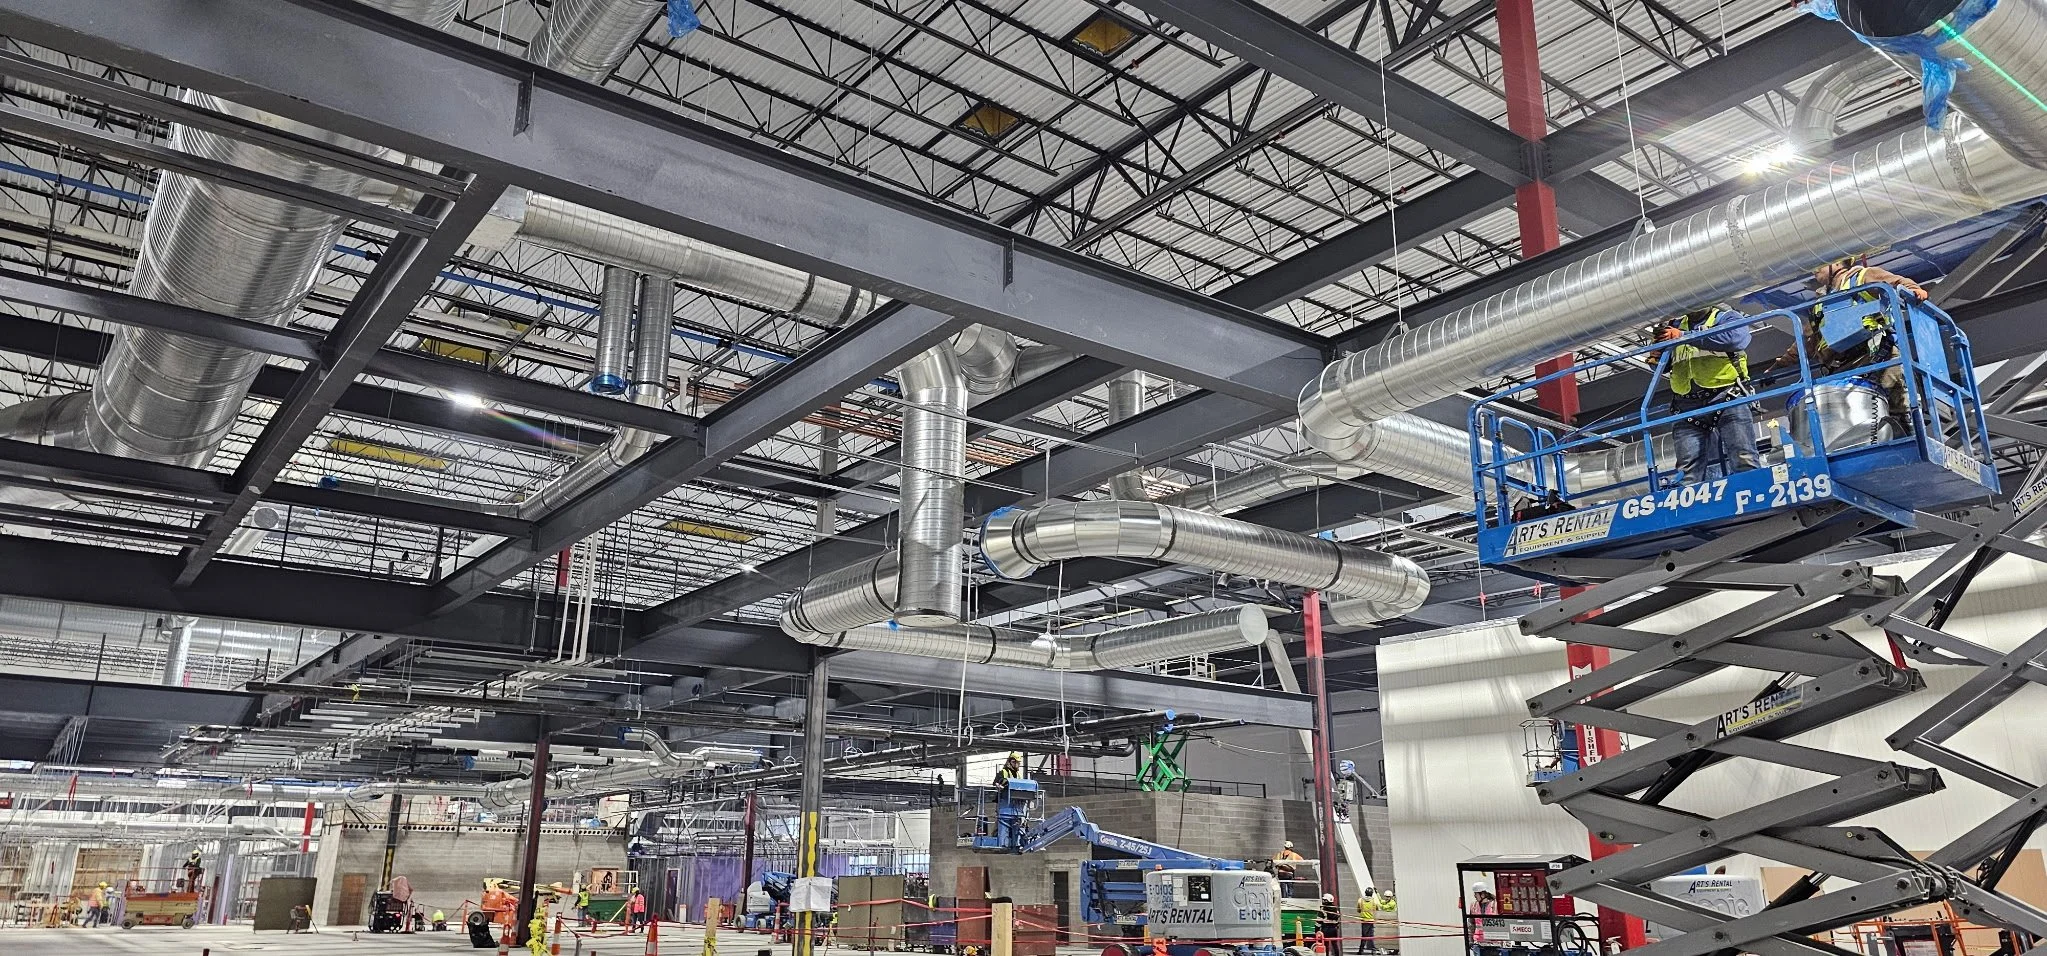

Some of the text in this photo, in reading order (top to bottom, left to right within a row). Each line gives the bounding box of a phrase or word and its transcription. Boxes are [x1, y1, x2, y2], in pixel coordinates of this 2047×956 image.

[1622, 479, 1728, 519] GS-4047
[2011, 491, 2032, 518] ART'S
[1504, 511, 1612, 558] ART'S RENTAL
[1519, 539, 1566, 552] EQUIPMENT
[1575, 531, 1607, 542] SUPPLY
[1716, 705, 1750, 740] ART'S
[1100, 834, 1118, 847] Genie
[1688, 879, 1733, 894] ART'S RENTAL
[1169, 908, 1214, 924] RENTAL
